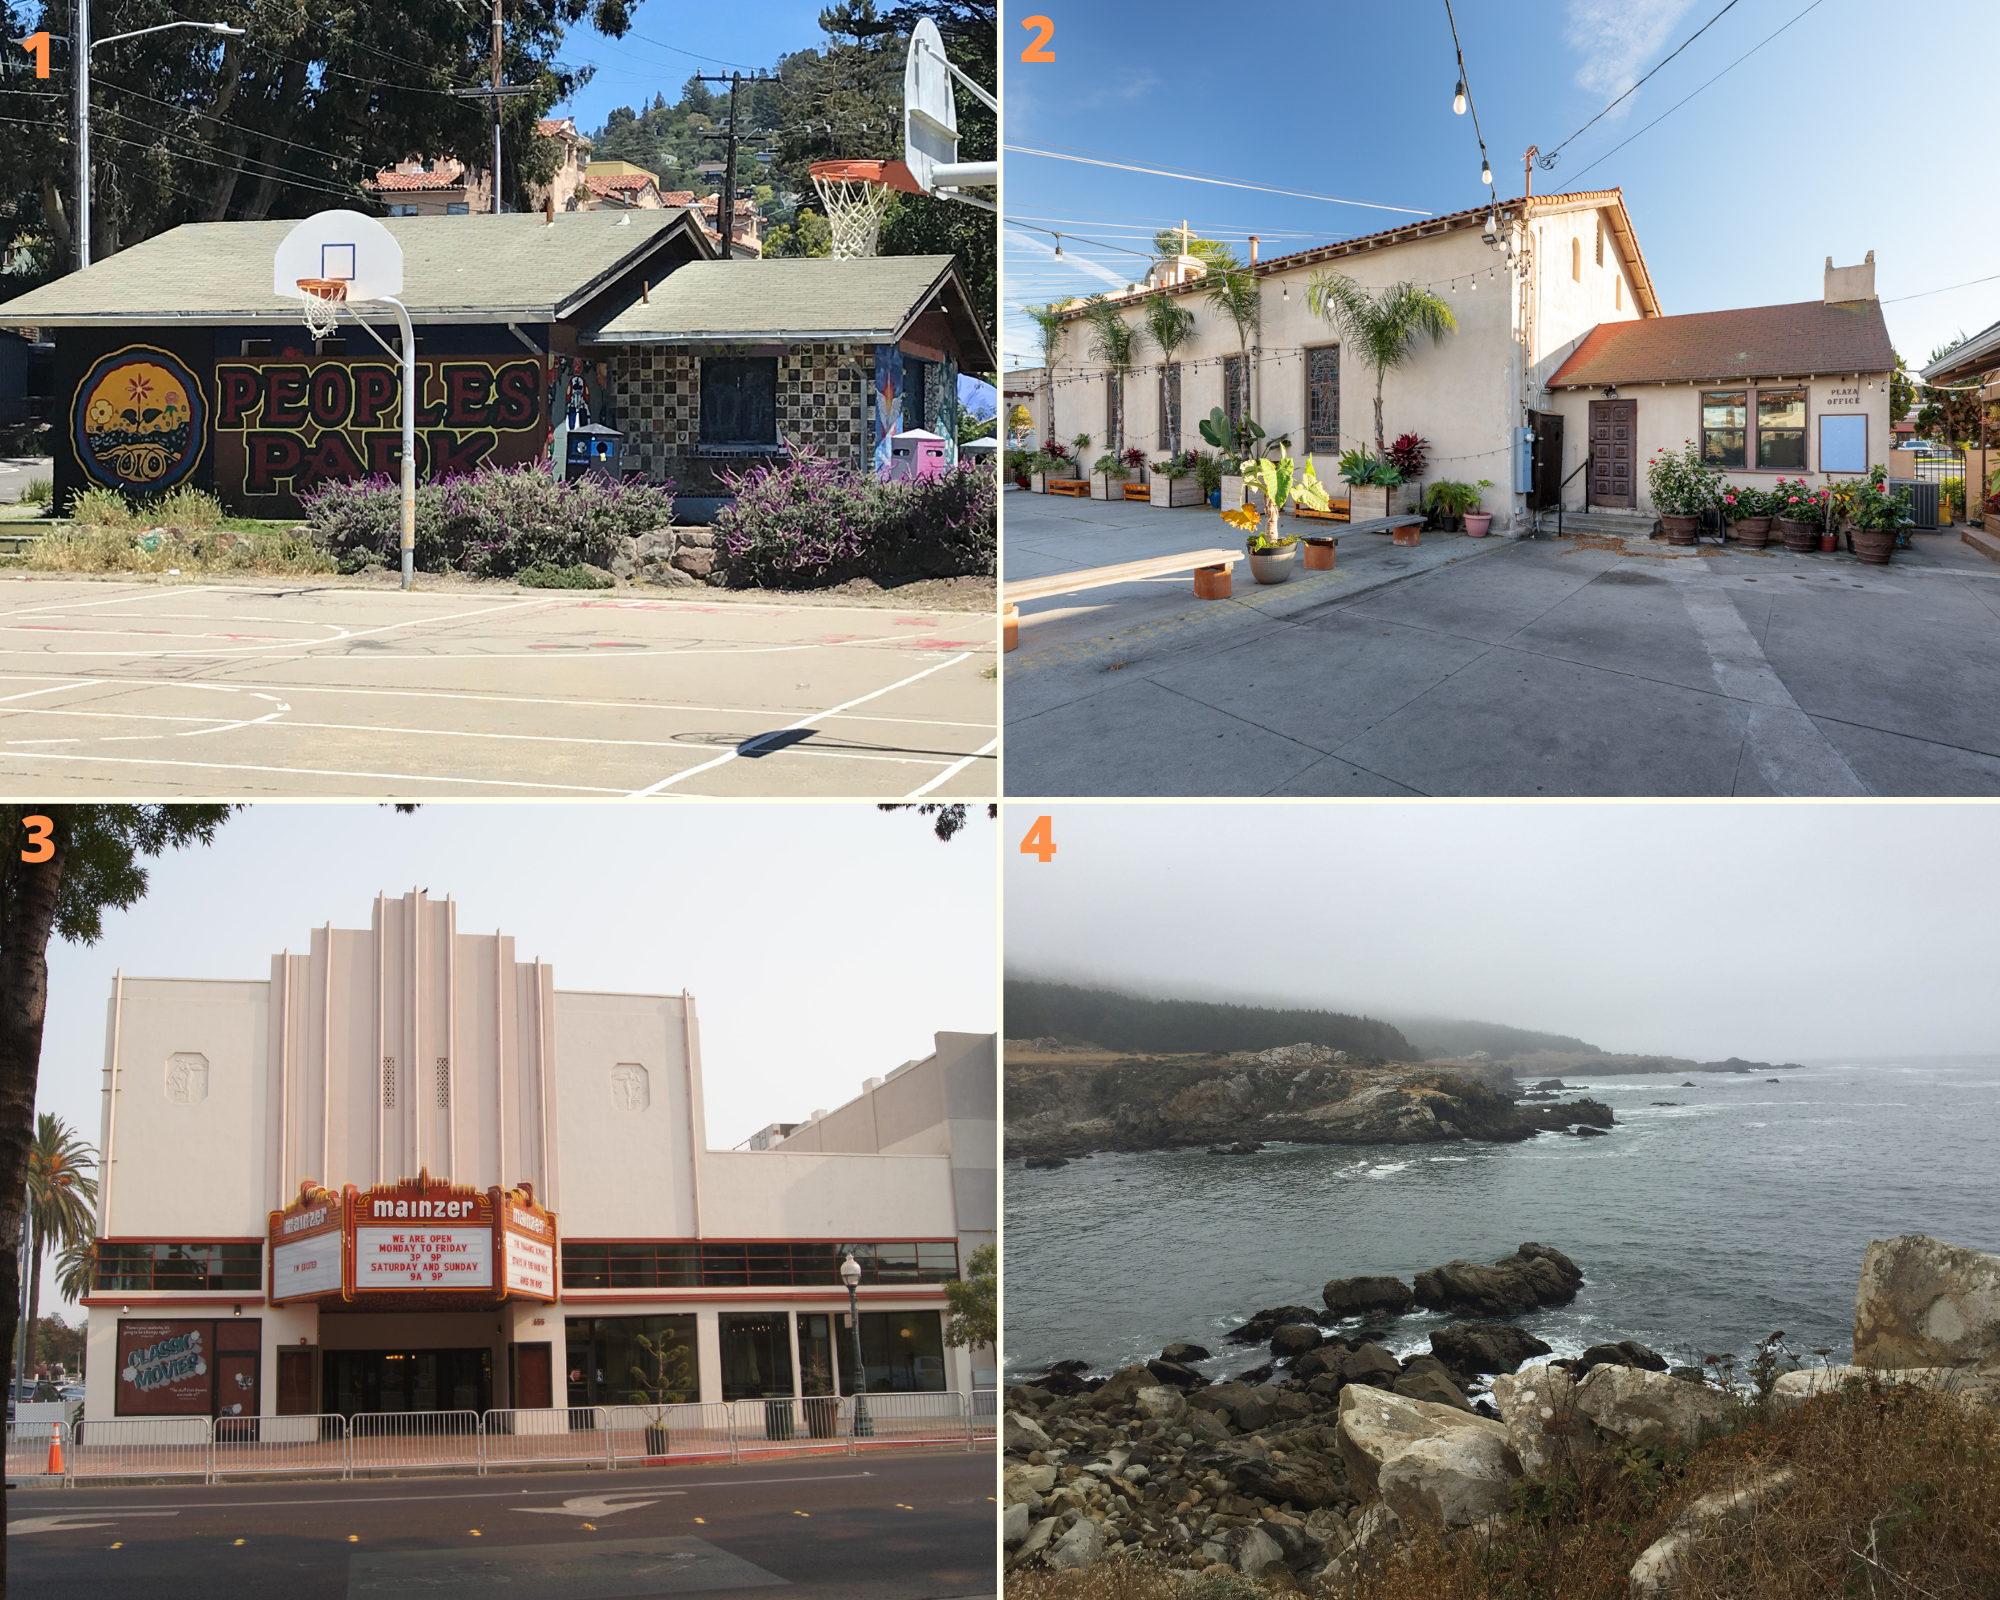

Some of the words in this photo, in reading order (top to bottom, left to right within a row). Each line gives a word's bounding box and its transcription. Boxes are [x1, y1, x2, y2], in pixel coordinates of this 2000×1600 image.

[215, 362, 540, 431] PEOPLES
[1831, 388, 1859, 396] PLAZA
[243, 430, 498, 496] PARK
[374, 1200, 474, 1218] mainzer
[284, 1207, 328, 1235] mainzer
[392, 1235, 404, 1243] WE
[409, 1235, 425, 1243] ARE
[430, 1235, 452, 1243] OPEN
[379, 1244, 416, 1252] MONDAY
[421, 1244, 432, 1252] TO
[436, 1244, 467, 1252] FRIDAY
[371, 1263, 418, 1271] SATURDAY
[423, 1263, 440, 1271] AND
[444, 1263, 478, 1271] SUNDAY
[410, 1272, 422, 1281] 9A
[432, 1272, 443, 1281] 9P
[533, 1318, 545, 1326] 655
[128, 1333, 196, 1368] CLASSIC
[135, 1354, 199, 1389] MOVIES
